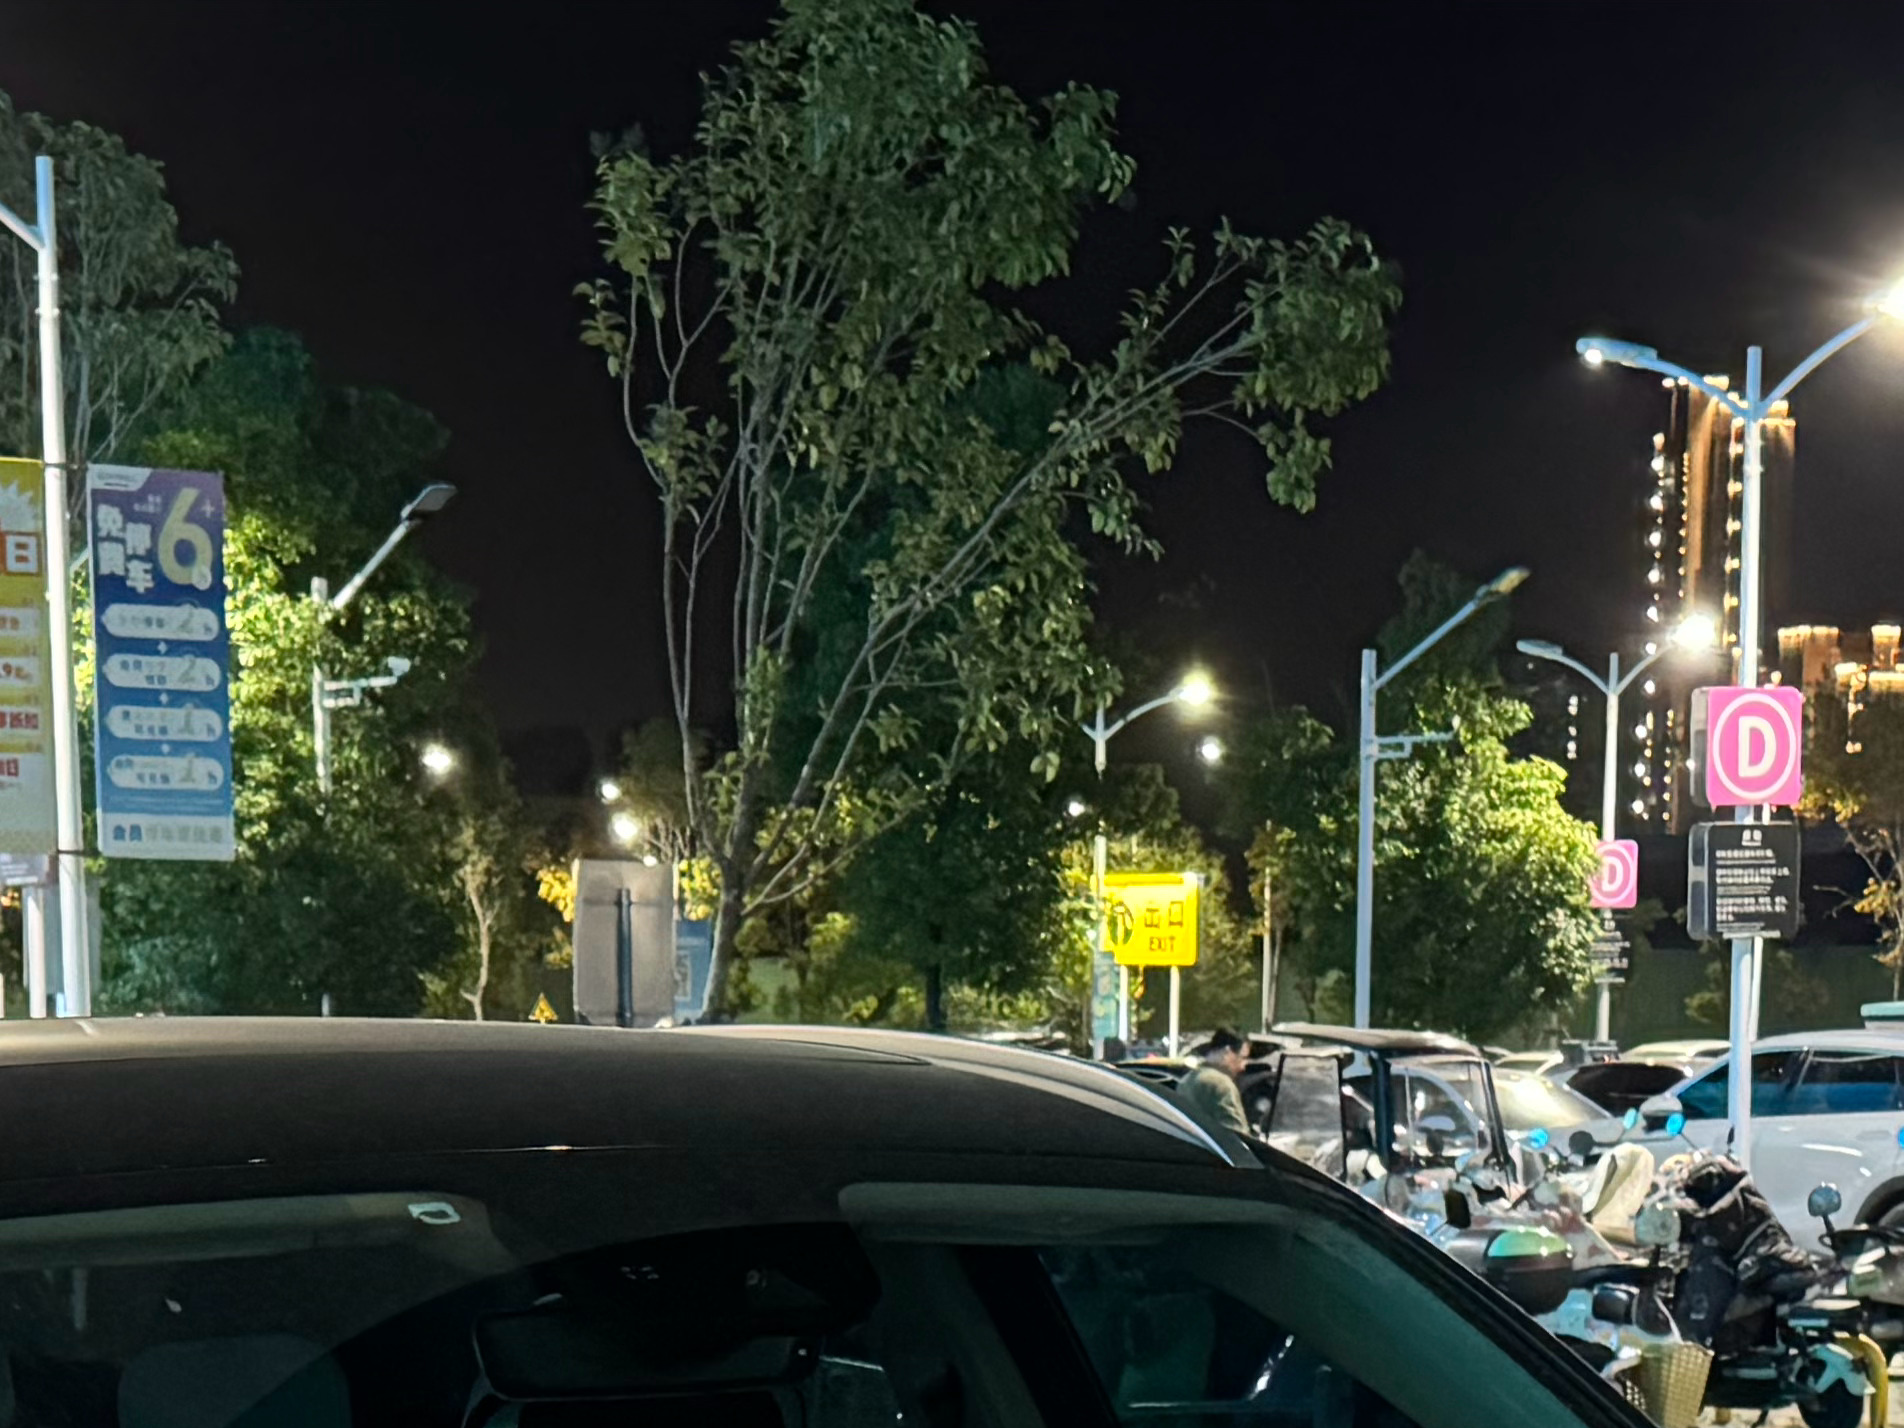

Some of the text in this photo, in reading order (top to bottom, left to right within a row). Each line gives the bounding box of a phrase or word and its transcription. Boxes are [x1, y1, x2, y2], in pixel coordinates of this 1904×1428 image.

[1737, 715, 1776, 778] D
[1602, 861, 1624, 892] D
[1143, 900, 1185, 929] 出口
[1148, 935, 1177, 953] EXIT
